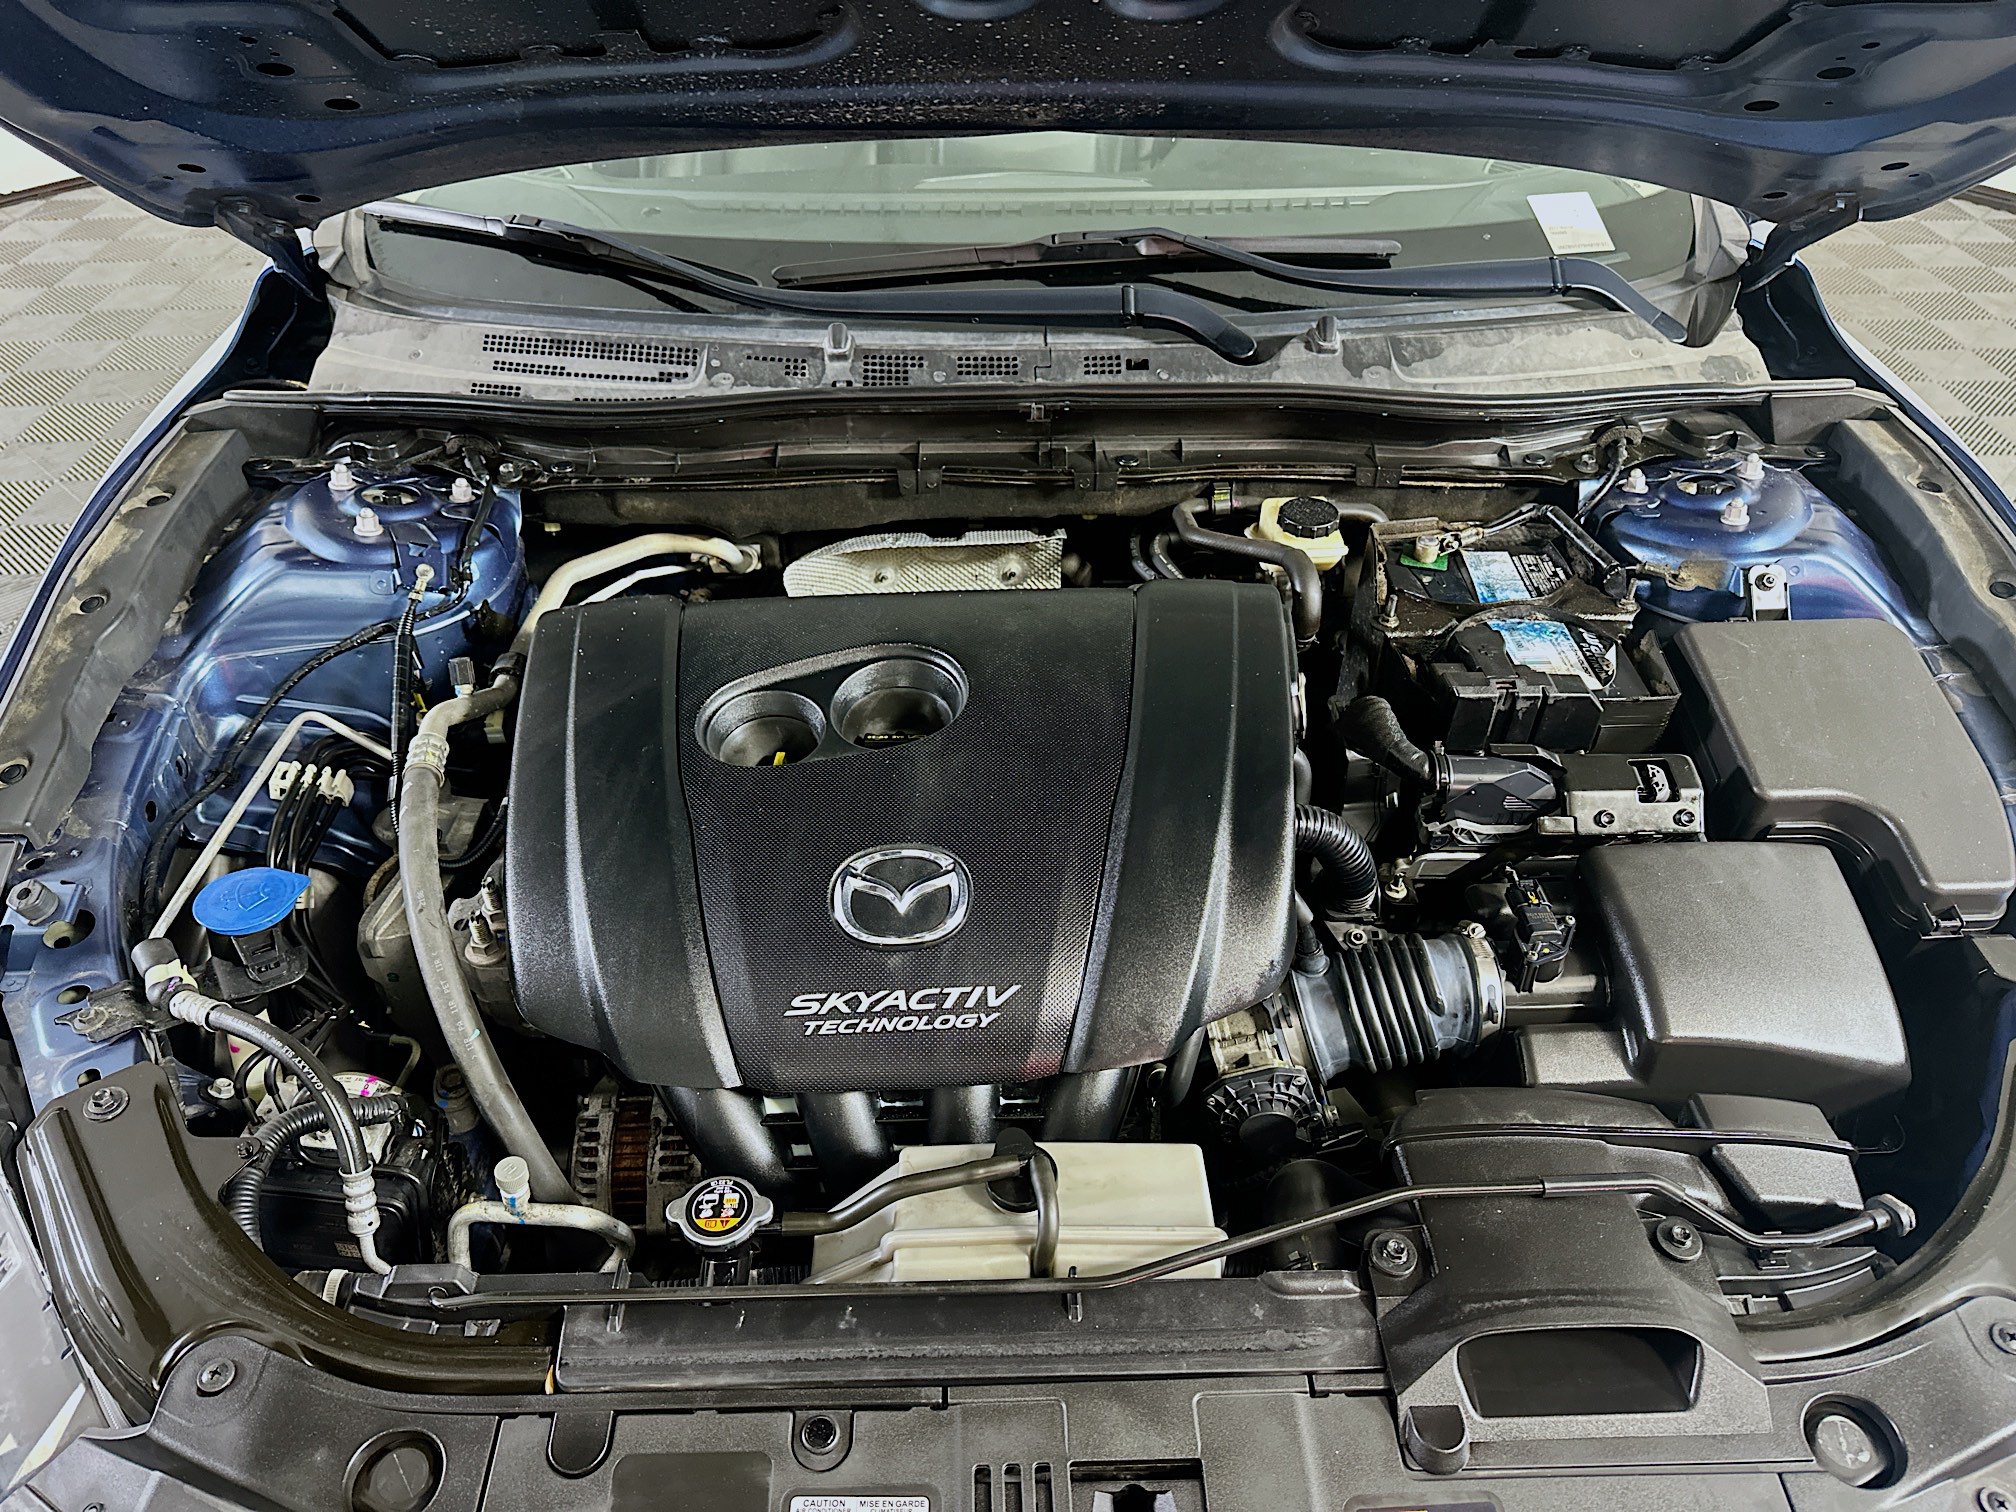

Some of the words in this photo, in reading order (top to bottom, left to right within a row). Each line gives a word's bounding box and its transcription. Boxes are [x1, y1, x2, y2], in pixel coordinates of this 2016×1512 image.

[784, 984, 1022, 1016] SKYACTIV
[804, 1012, 1000, 1036] TECHNOLOGY
[281, 1045, 296, 1058] SLE
[291, 1056, 324, 1091] GALAXY
[803, 1499, 846, 1507] CAUTION
[859, 1500, 880, 1508] MISE
[882, 1500, 894, 1508] EN
[895, 1500, 926, 1508] GARDE
